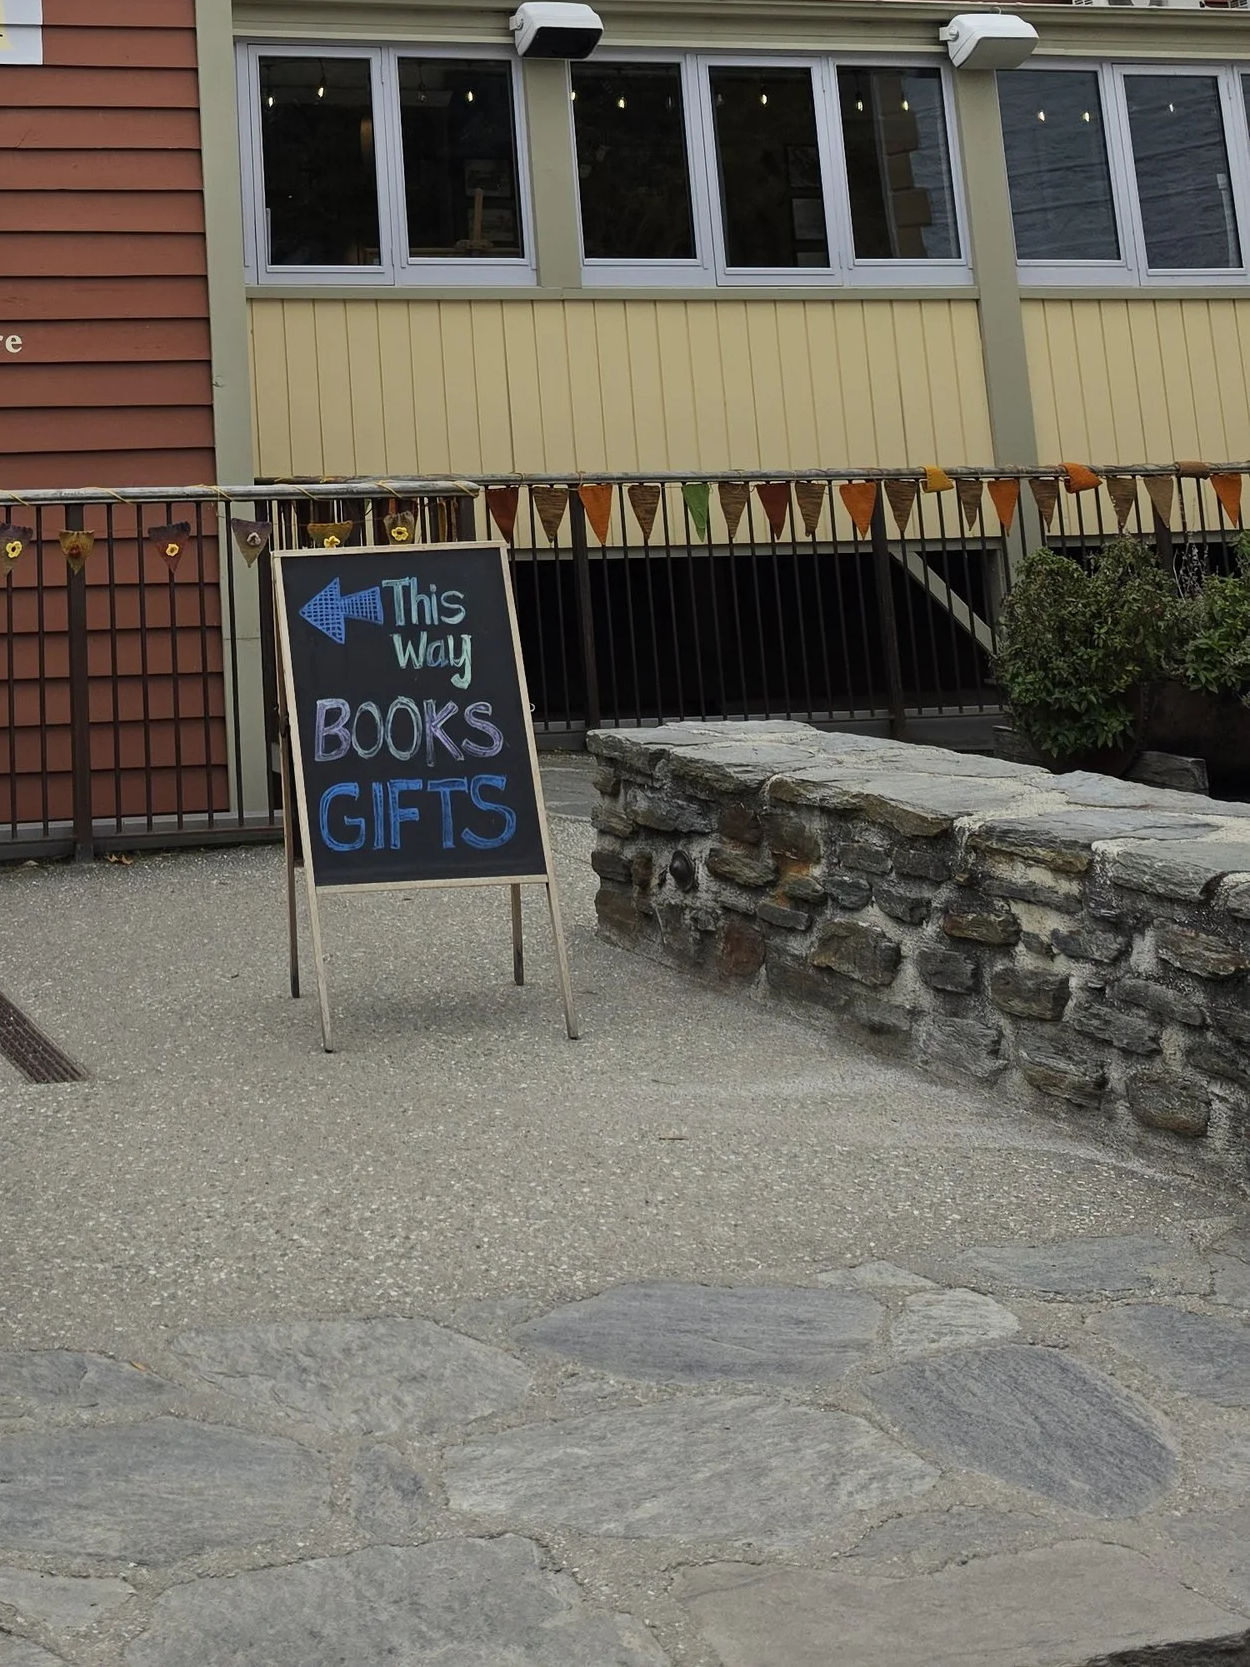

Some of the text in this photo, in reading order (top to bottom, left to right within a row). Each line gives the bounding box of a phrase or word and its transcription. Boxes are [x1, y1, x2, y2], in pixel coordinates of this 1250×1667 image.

[381, 576, 466, 627] This
[314, 695, 505, 768] BOOKS
[318, 774, 517, 853] GIFTS
